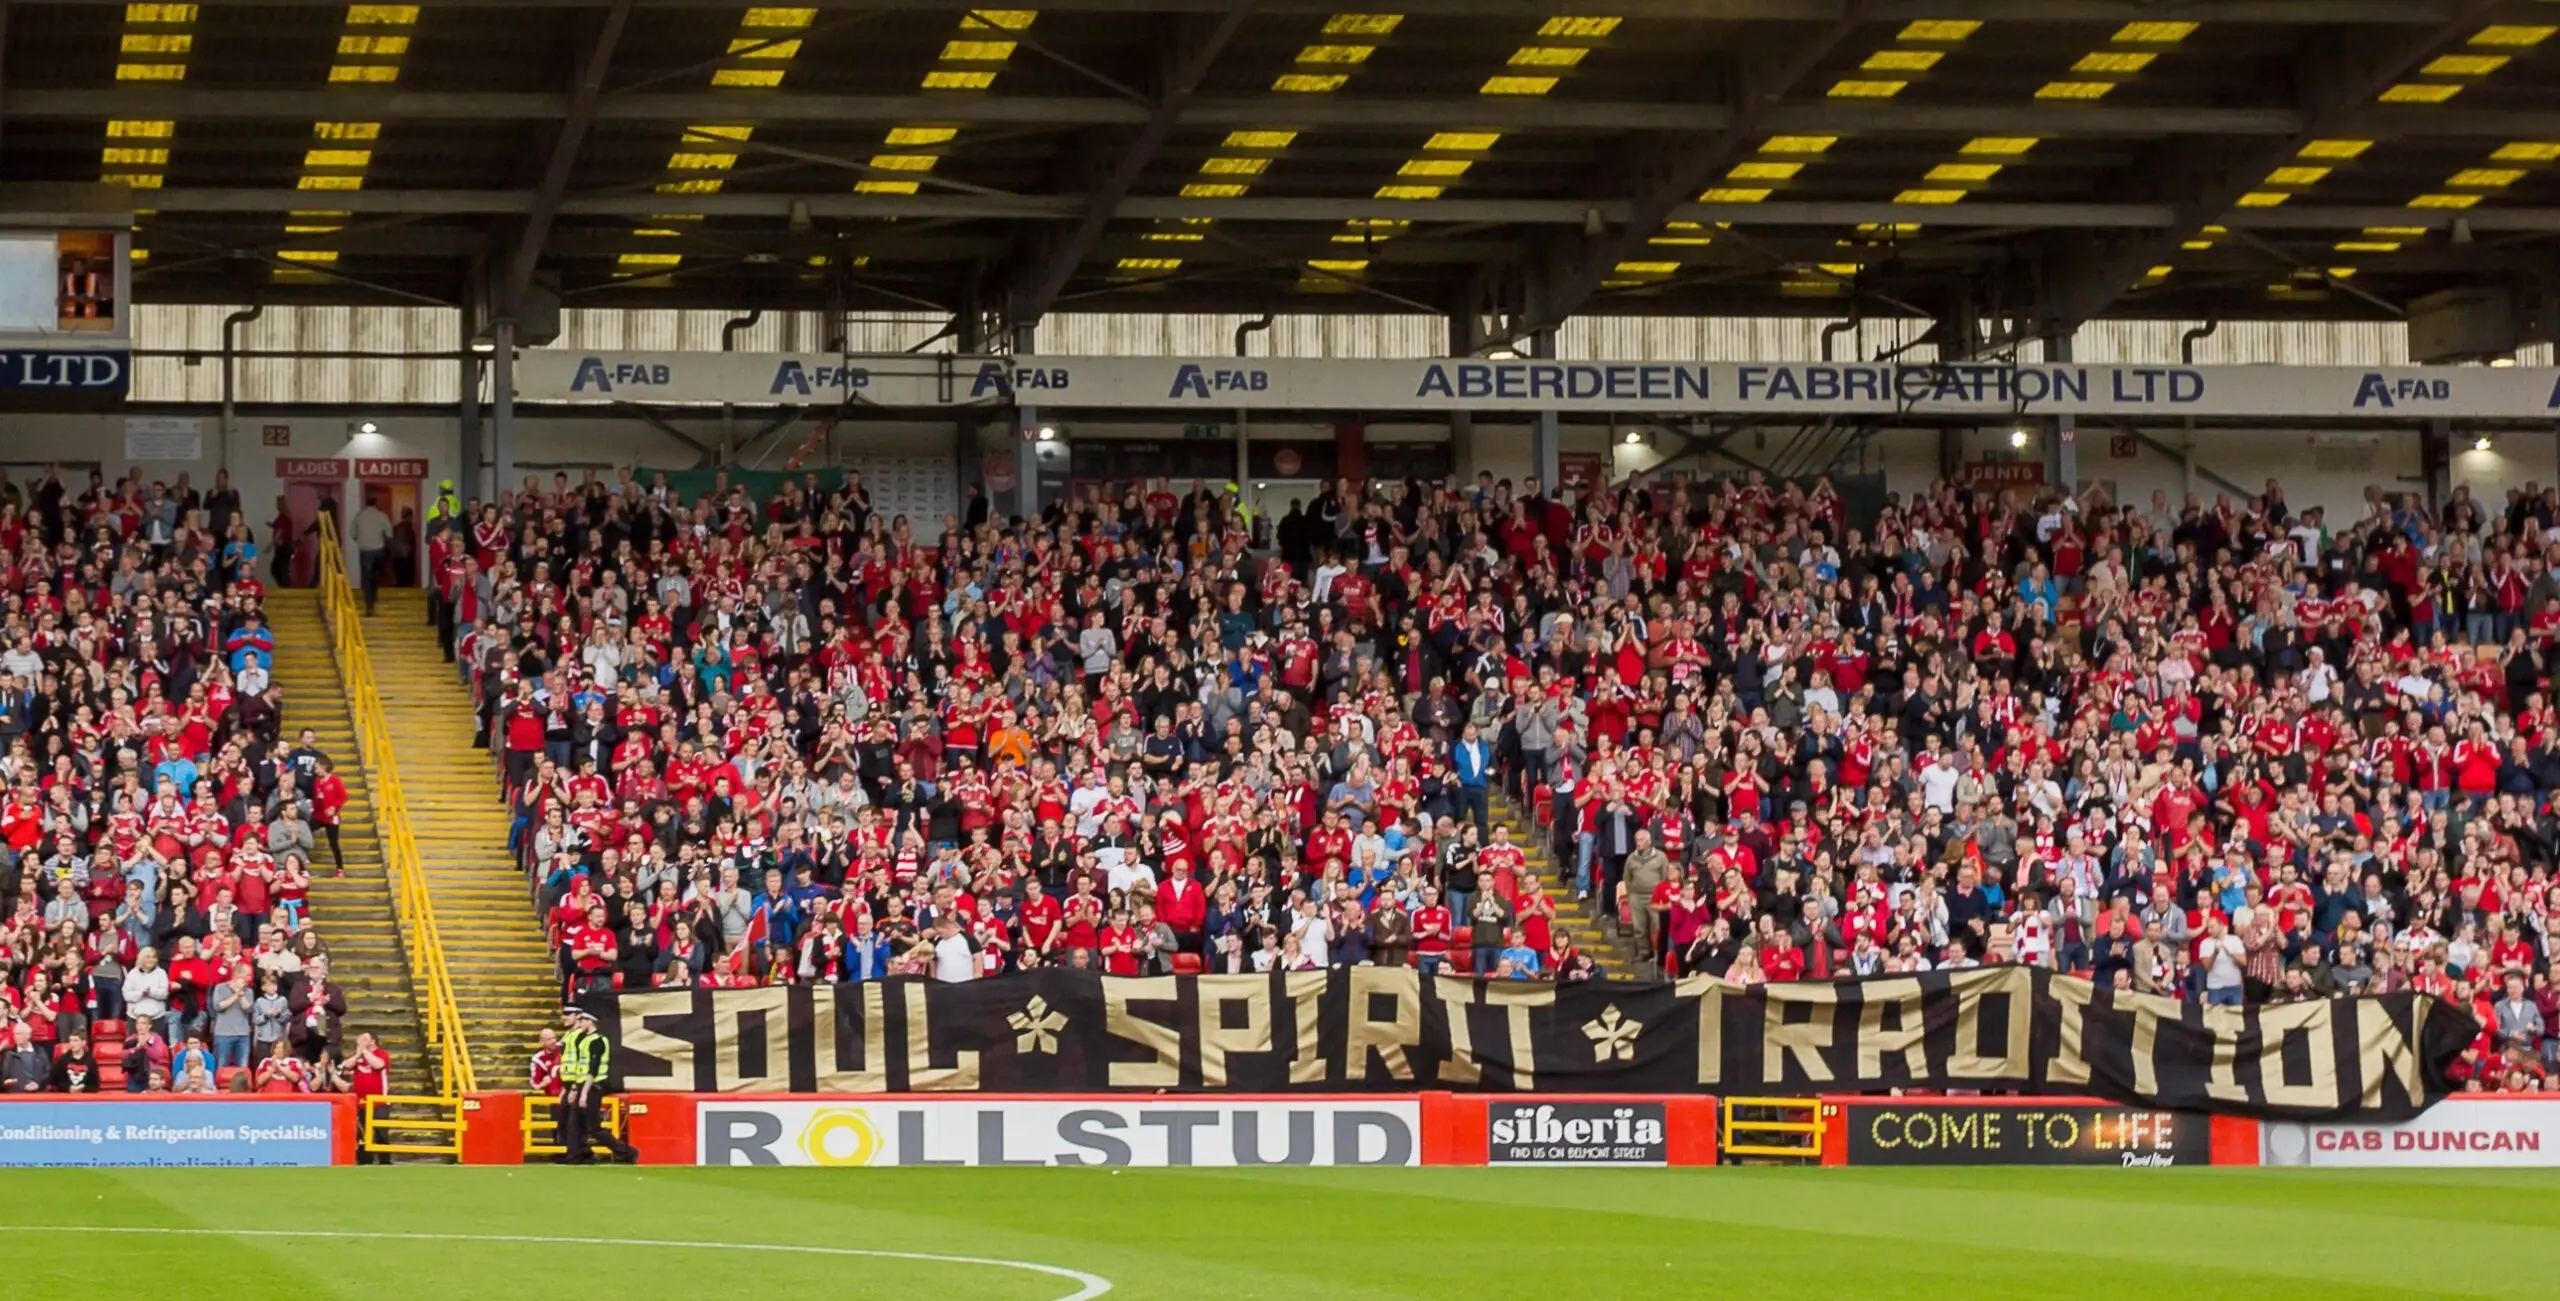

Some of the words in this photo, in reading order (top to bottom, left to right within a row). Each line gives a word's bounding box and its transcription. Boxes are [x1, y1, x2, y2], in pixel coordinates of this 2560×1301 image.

[20, 354, 120, 386] LTD
[1416, 364, 1709, 399] ABERDEEN
[1739, 367, 2087, 402] FABRICATION
[2113, 369, 2205, 402] LTD
[265, 428, 288, 444] 22
[2061, 431, 2074, 442] W
[287, 462, 339, 475] LADIES
[359, 462, 422, 476] LADIES
[618, 981, 980, 1091] SOUL
[1101, 965, 1556, 1090] SPIRIT
[1675, 966, 2434, 1108] TRADITION
[106, 1125, 121, 1140] &
[125, 1125, 235, 1144] Refrigeration
[239, 1125, 328, 1144] Specialists
[705, 1107, 1412, 1166] ROLLSTUD
[1872, 1112, 2001, 1149] COME
[2016, 1112, 2079, 1149] TO
[2094, 1112, 2173, 1150] LIFE
[2393, 1131, 2540, 1151] DUNCAN
[1510, 1147, 1531, 1159] FIND
[1533, 1147, 1546, 1159] US
[1548, 1147, 1565, 1159] ON
[1567, 1146, 1610, 1159] BELMONT
[1613, 1146, 1646, 1159] STREET
